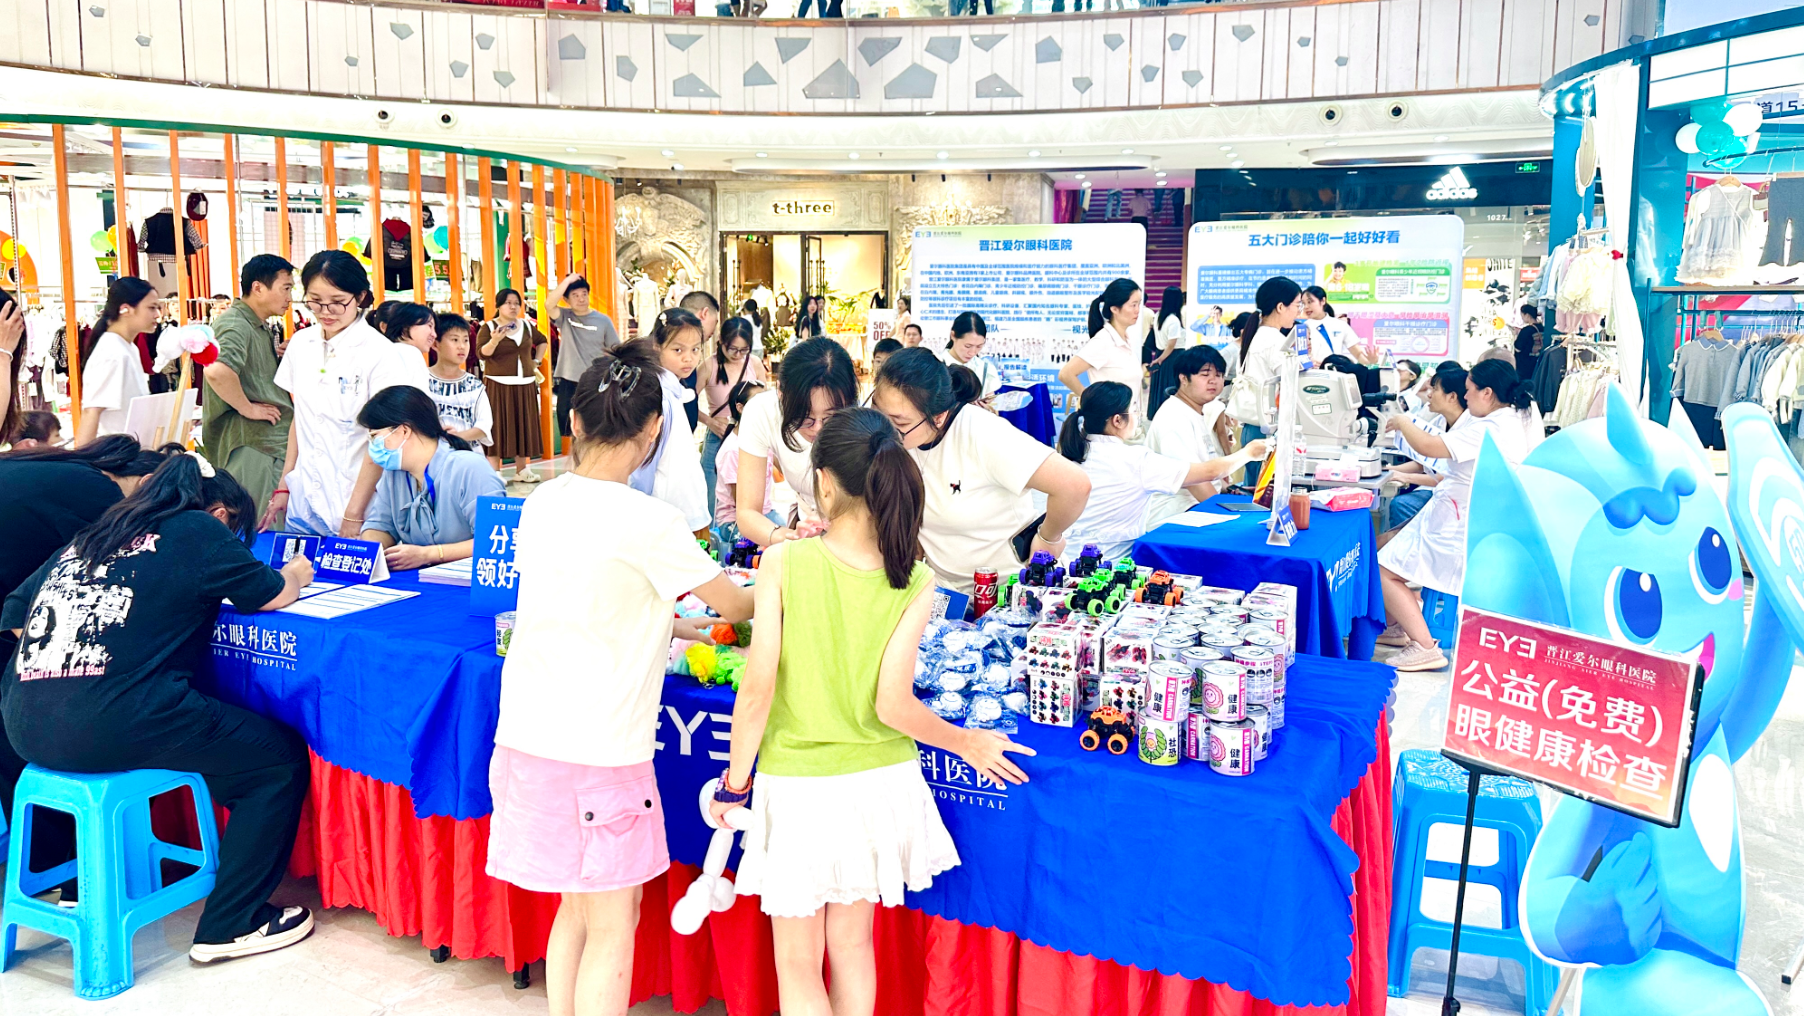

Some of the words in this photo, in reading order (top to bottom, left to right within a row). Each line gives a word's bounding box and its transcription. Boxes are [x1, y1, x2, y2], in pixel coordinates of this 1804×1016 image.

[1426, 187, 1477, 200] adidas
[772, 201, 832, 214] t-three
[979, 239, 1073, 252] 晋江爱尔眼科医院
[1248, 230, 1400, 247] 五大门诊陪你一起好好看
[873, 321, 891, 330] 50%
[873, 331, 890, 341] OFF
[321, 552, 372, 575] 检查登记处
[476, 557, 518, 589] 领好
[213, 648, 229, 657] IER
[252, 656, 296, 671] HOSPITAL
[1546, 645, 1657, 684] 晋江爱尔眼科医院
[1461, 659, 1663, 748] 公益(免费)
[1455, 703, 1667, 801] 眼健康检查
